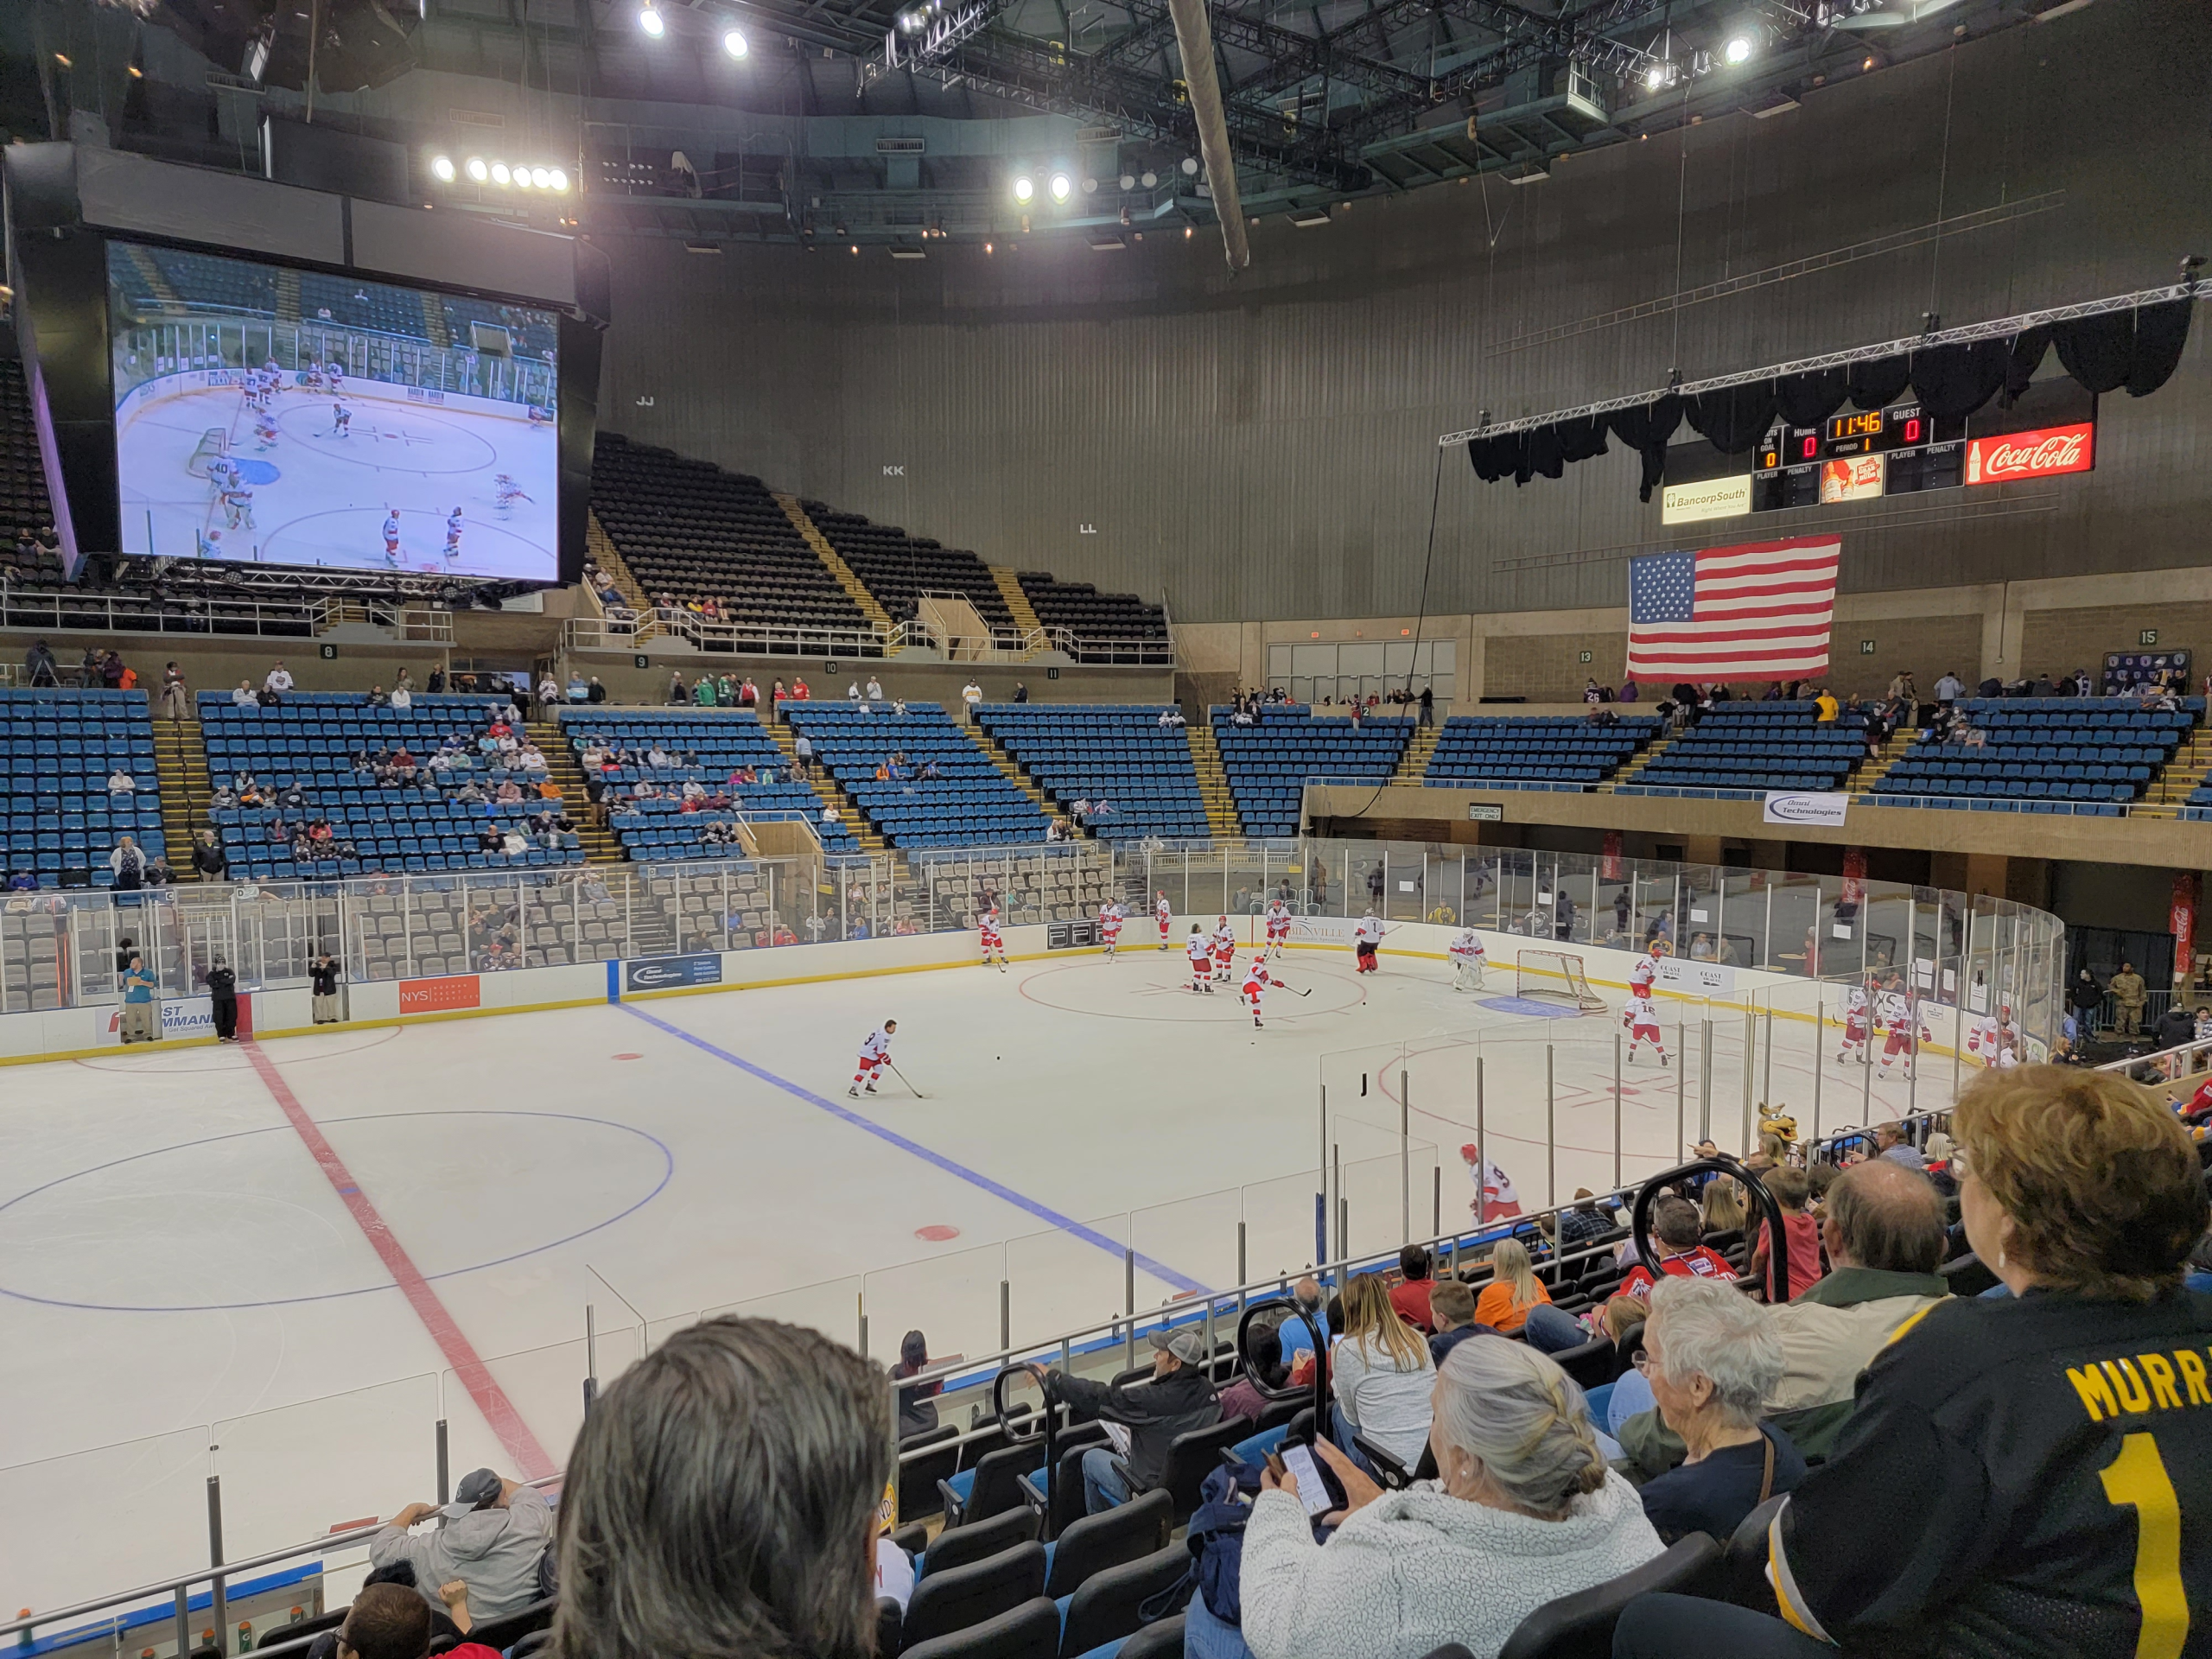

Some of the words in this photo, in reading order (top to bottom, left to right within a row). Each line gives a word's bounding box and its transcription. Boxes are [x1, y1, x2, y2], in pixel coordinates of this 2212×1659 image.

[636, 396, 654, 406] JJ
[1893, 407, 1921, 421] GUEST
[1836, 411, 1881, 437] 11:46
[1905, 419, 1920, 441] 0
[1803, 436, 1817, 457] 0
[1835, 442, 1859, 453] PERIOD
[1865, 437, 1870, 451] 1
[1927, 443, 1955, 455] PENALTY
[1891, 450, 1916, 460] PLAYER
[1986, 432, 2088, 475] Coca-Cola
[1766, 452, 1777, 467] 0
[883, 466, 904, 475] KK
[1757, 470, 1778, 480] PLAYER
[1787, 466, 1813, 475] PENALTY
[1677, 489, 1745, 507] BancorpSouth
[1080, 524, 1096, 534] LL
[2142, 631, 2156, 643] 15
[325, 646, 333, 657] 8
[1863, 641, 1873, 652] 14
[639, 657, 645, 666] 9
[1580, 652, 1591, 661] 13
[827, 663, 836, 672] 10
[1050, 669, 1056, 677] 11
[1587, 692, 1599, 703] 26
[1783, 807, 1841, 816] Technologies
[402, 990, 429, 1002] NYS
[162, 1006, 183, 1017] ST
[2065, 1346, 2212, 1422] MURR
[2099, 1432, 2190, 1659] 1
